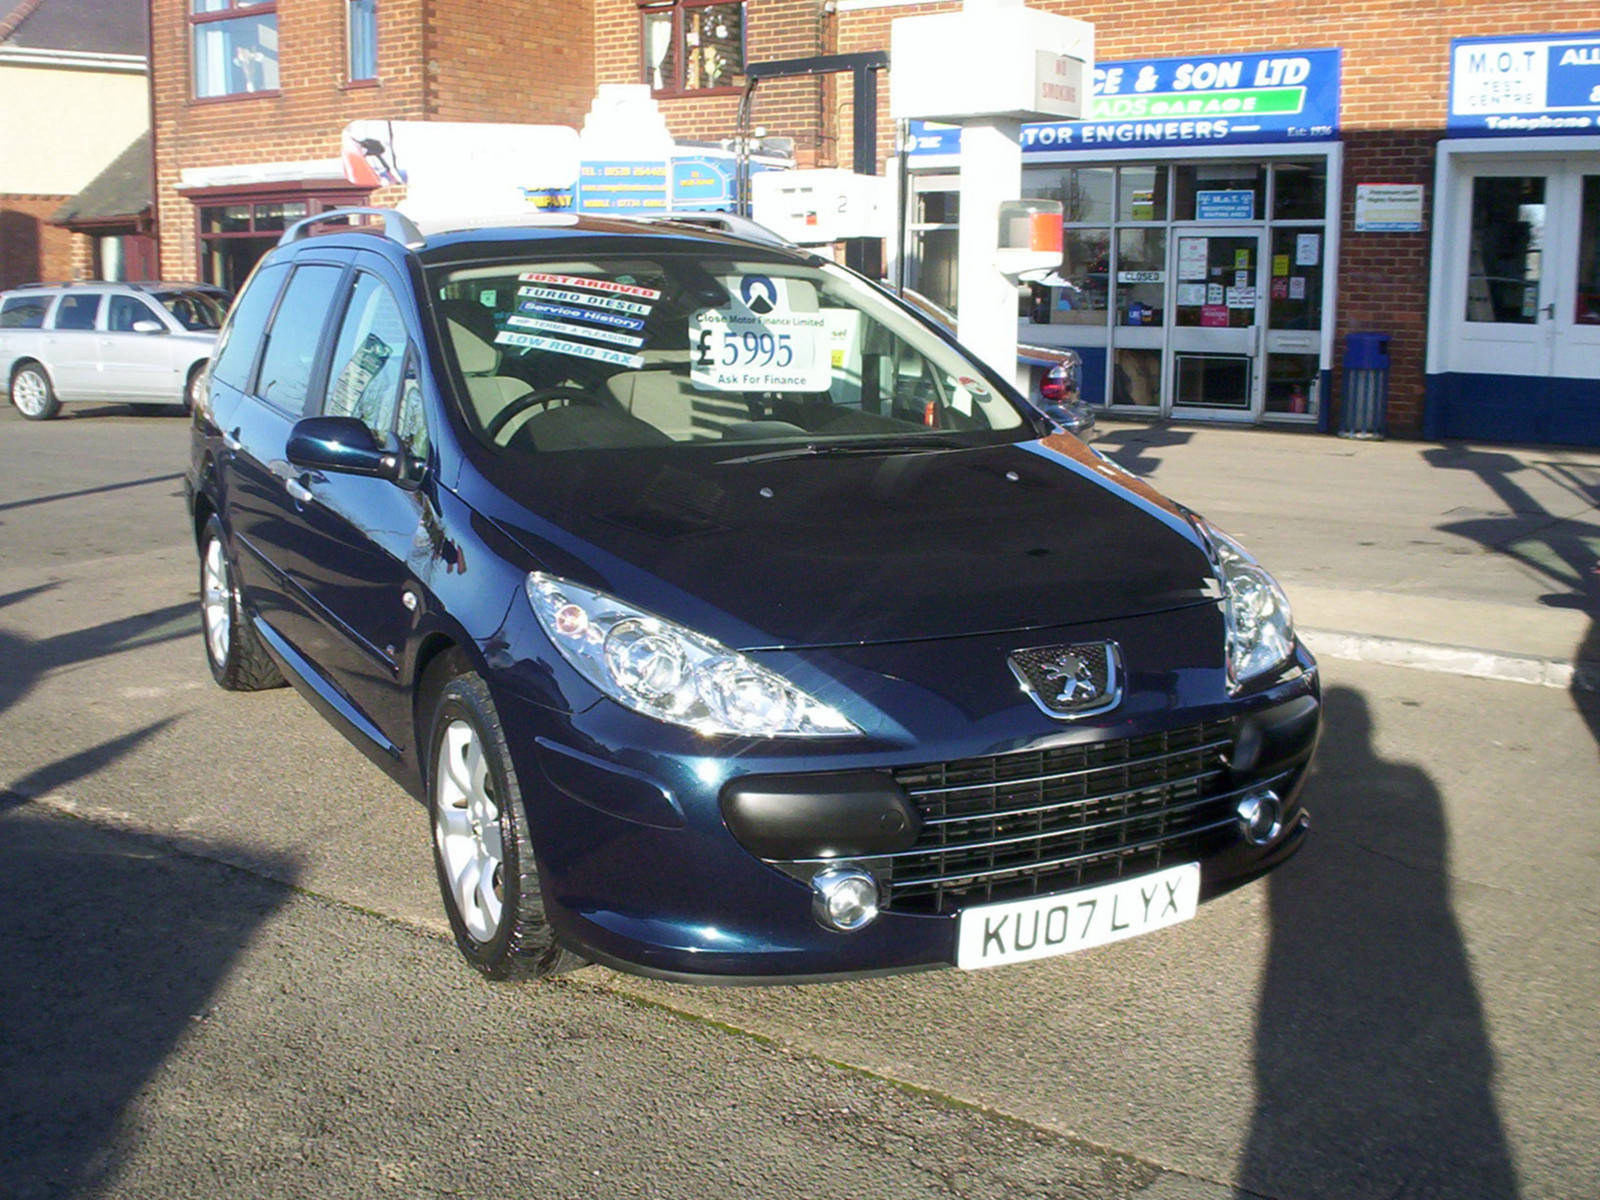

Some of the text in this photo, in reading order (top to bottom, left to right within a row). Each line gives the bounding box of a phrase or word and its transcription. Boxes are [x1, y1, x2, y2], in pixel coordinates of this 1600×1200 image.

[1134, 66, 1158, 92] &
[1172, 61, 1243, 90] SON
[1254, 58, 1310, 86] LTD
[1150, 97, 1257, 115] GARAGE
[1081, 119, 1229, 143] ENGINEERS
[1485, 115, 1592, 130] Telephone
[526, 273, 655, 298] JUST ARRIVED
[1125, 272, 1160, 281] CLOSED
[524, 287, 645, 314] TURBO DIESEL
[524, 302, 639, 329] Service History
[695, 312, 825, 328] Close Motor Finance Limited
[506, 334, 633, 366] LOW ROAD TAX
[717, 374, 807, 385] Ask For Finance
[1110, 876, 1182, 932] LYX
